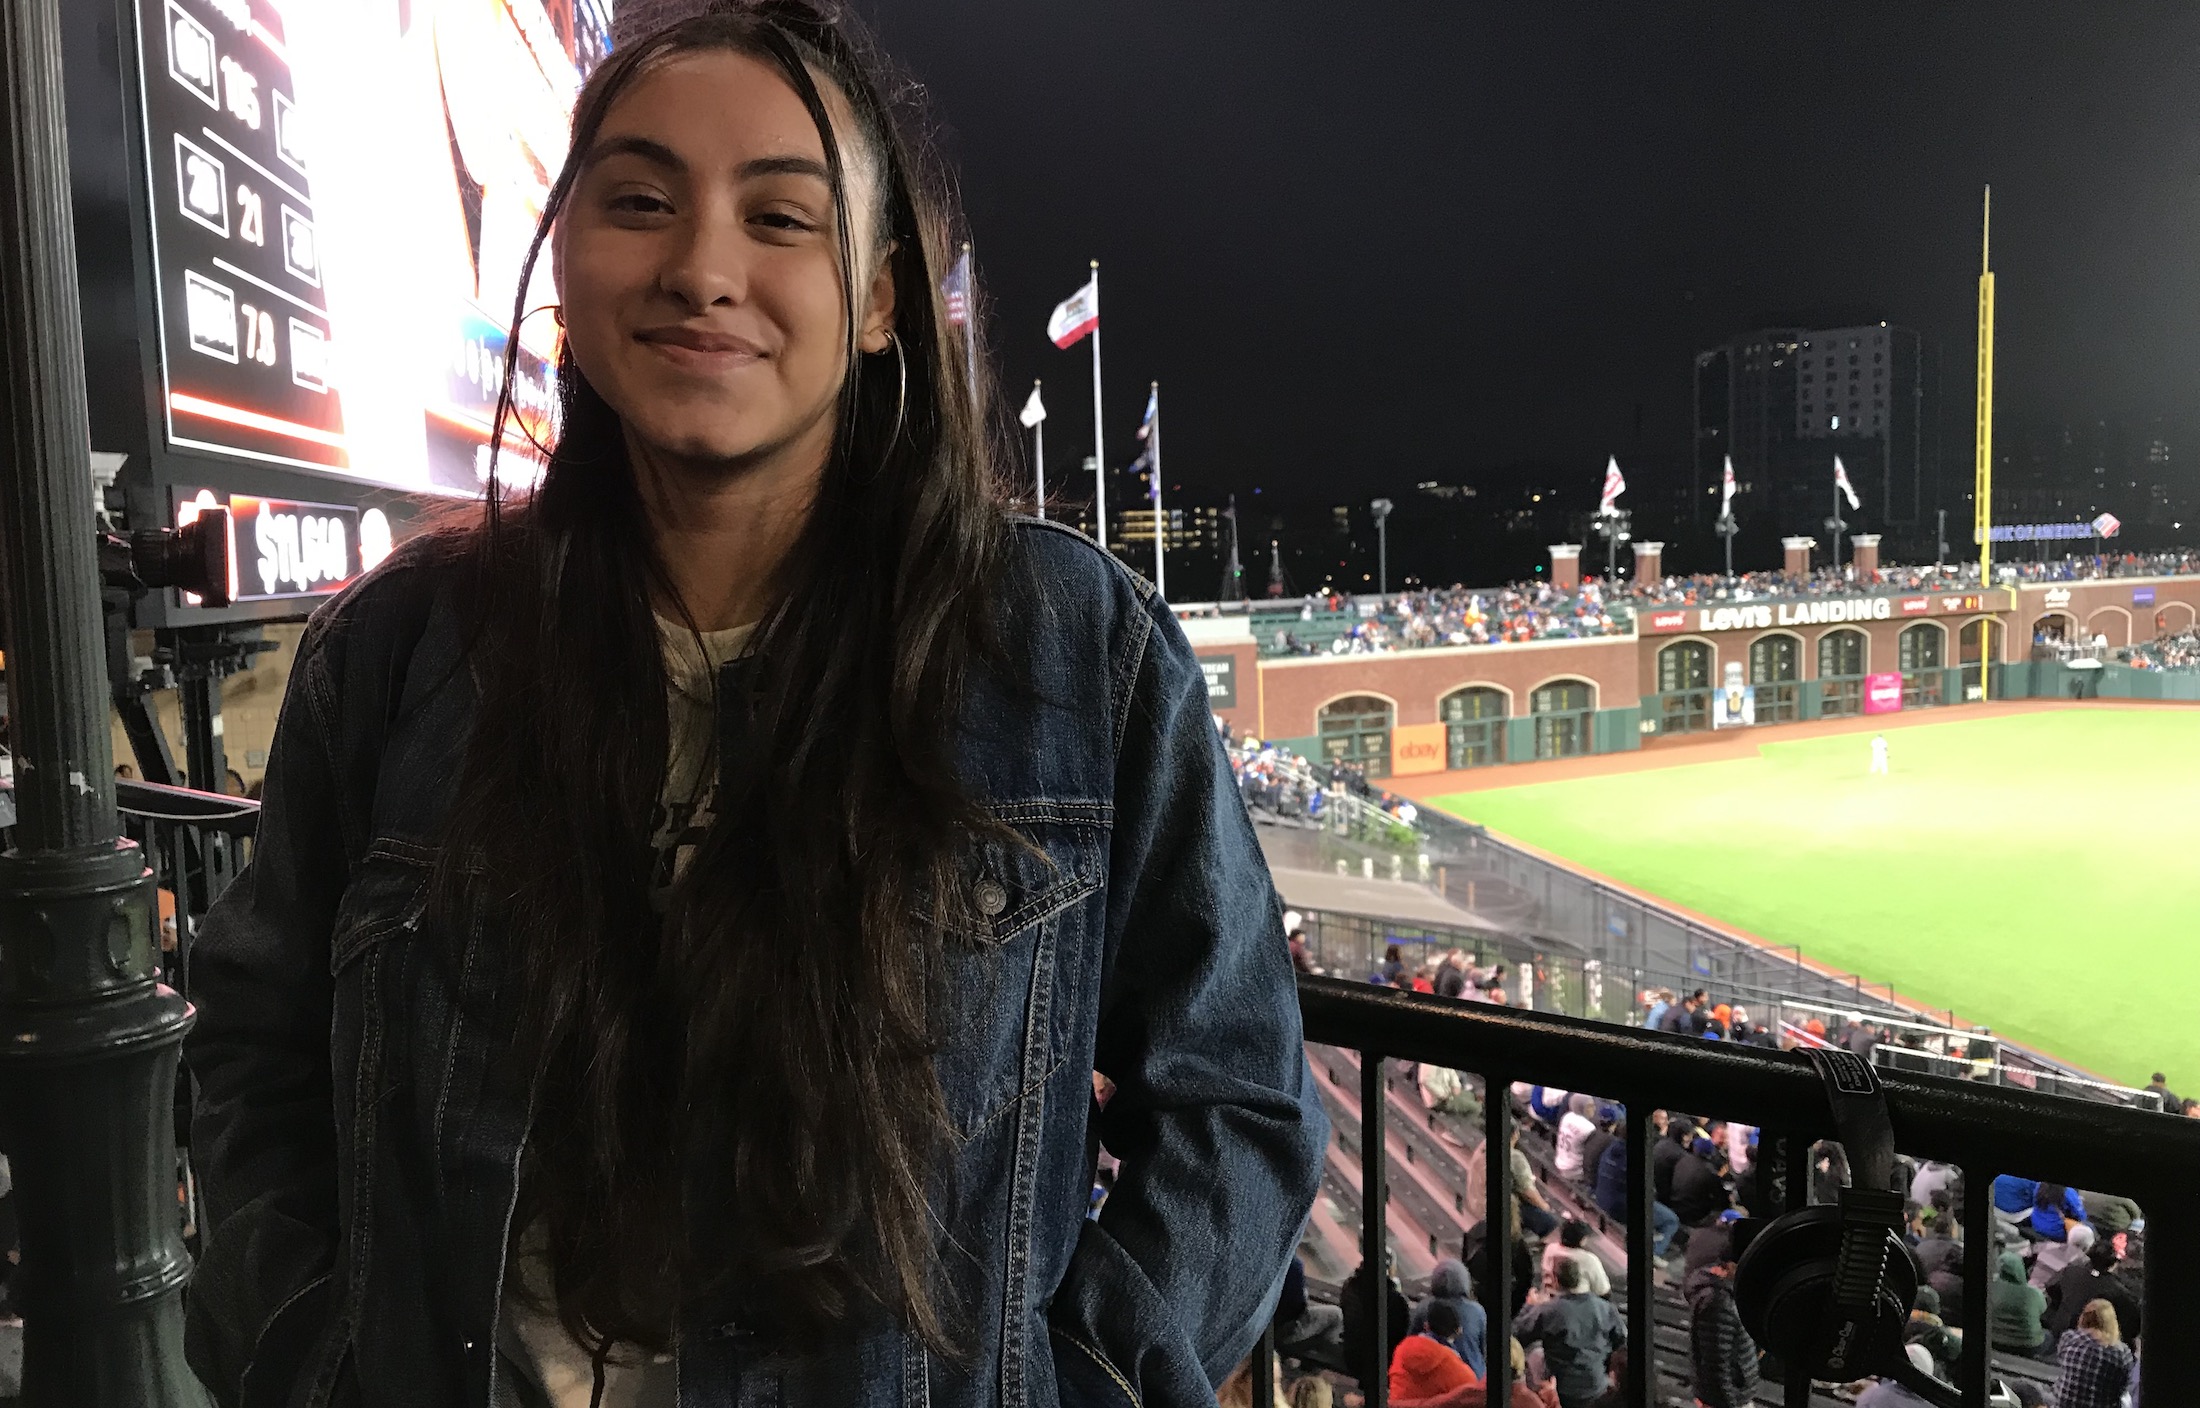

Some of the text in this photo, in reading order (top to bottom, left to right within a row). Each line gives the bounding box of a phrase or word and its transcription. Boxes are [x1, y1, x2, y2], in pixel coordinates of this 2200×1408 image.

[237, 184, 264, 247] 21
[2035, 522, 2093, 540] AMERICA
[1778, 598, 1890, 625] LANDING
[1200, 662, 1229, 674] TREAM
[1208, 685, 1229, 697] NTS.
[1400, 742, 1440, 760] ebay
